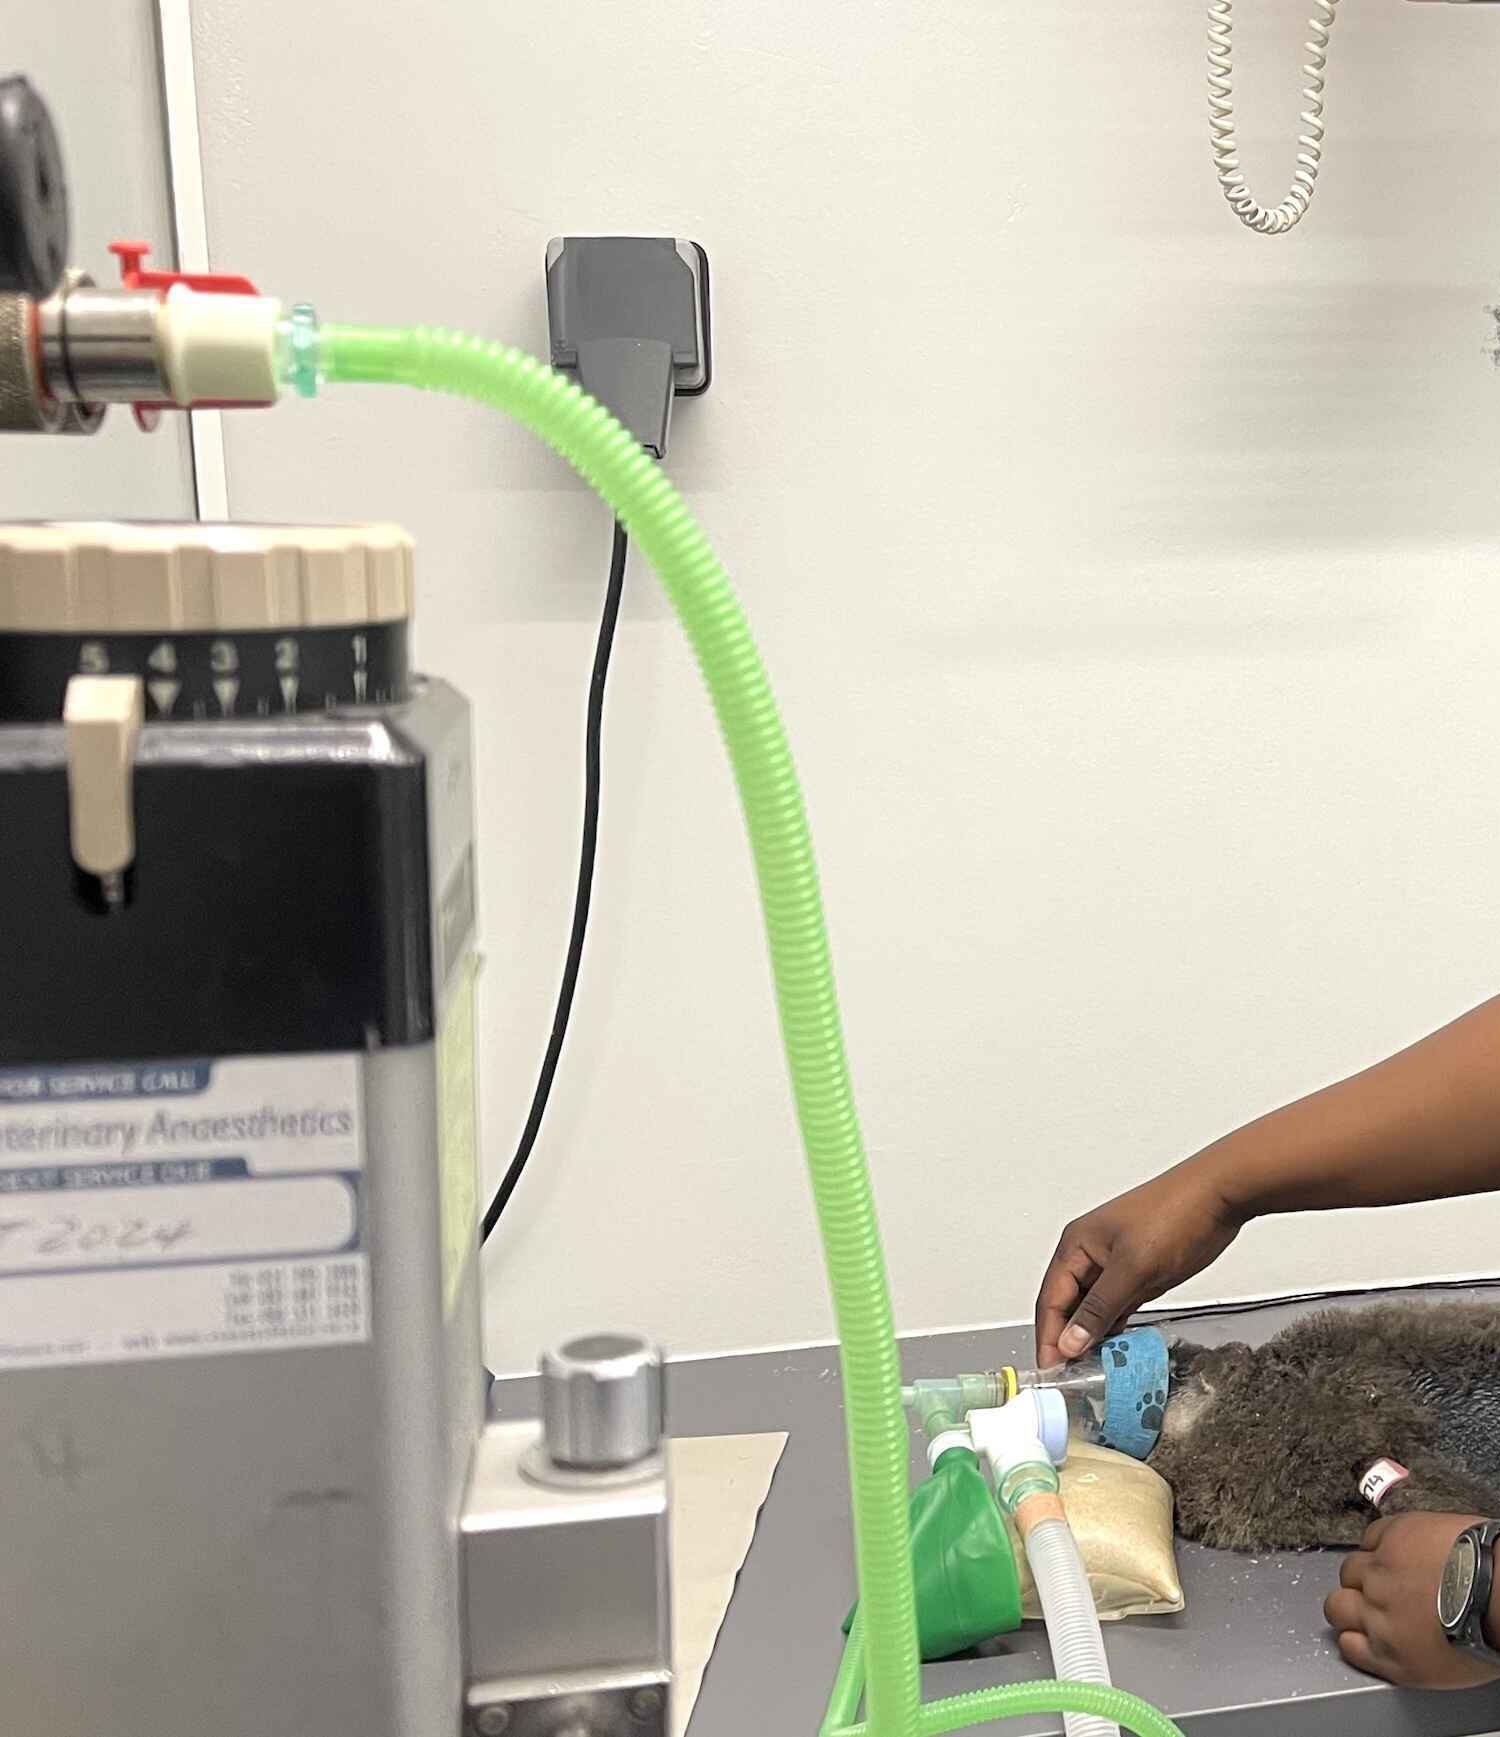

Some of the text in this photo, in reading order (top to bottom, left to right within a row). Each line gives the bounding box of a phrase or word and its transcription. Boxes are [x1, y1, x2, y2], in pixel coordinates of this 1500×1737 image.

[147, 640, 178, 673] 4
[210, 640, 240, 673] 3
[274, 637, 300, 670] 2
